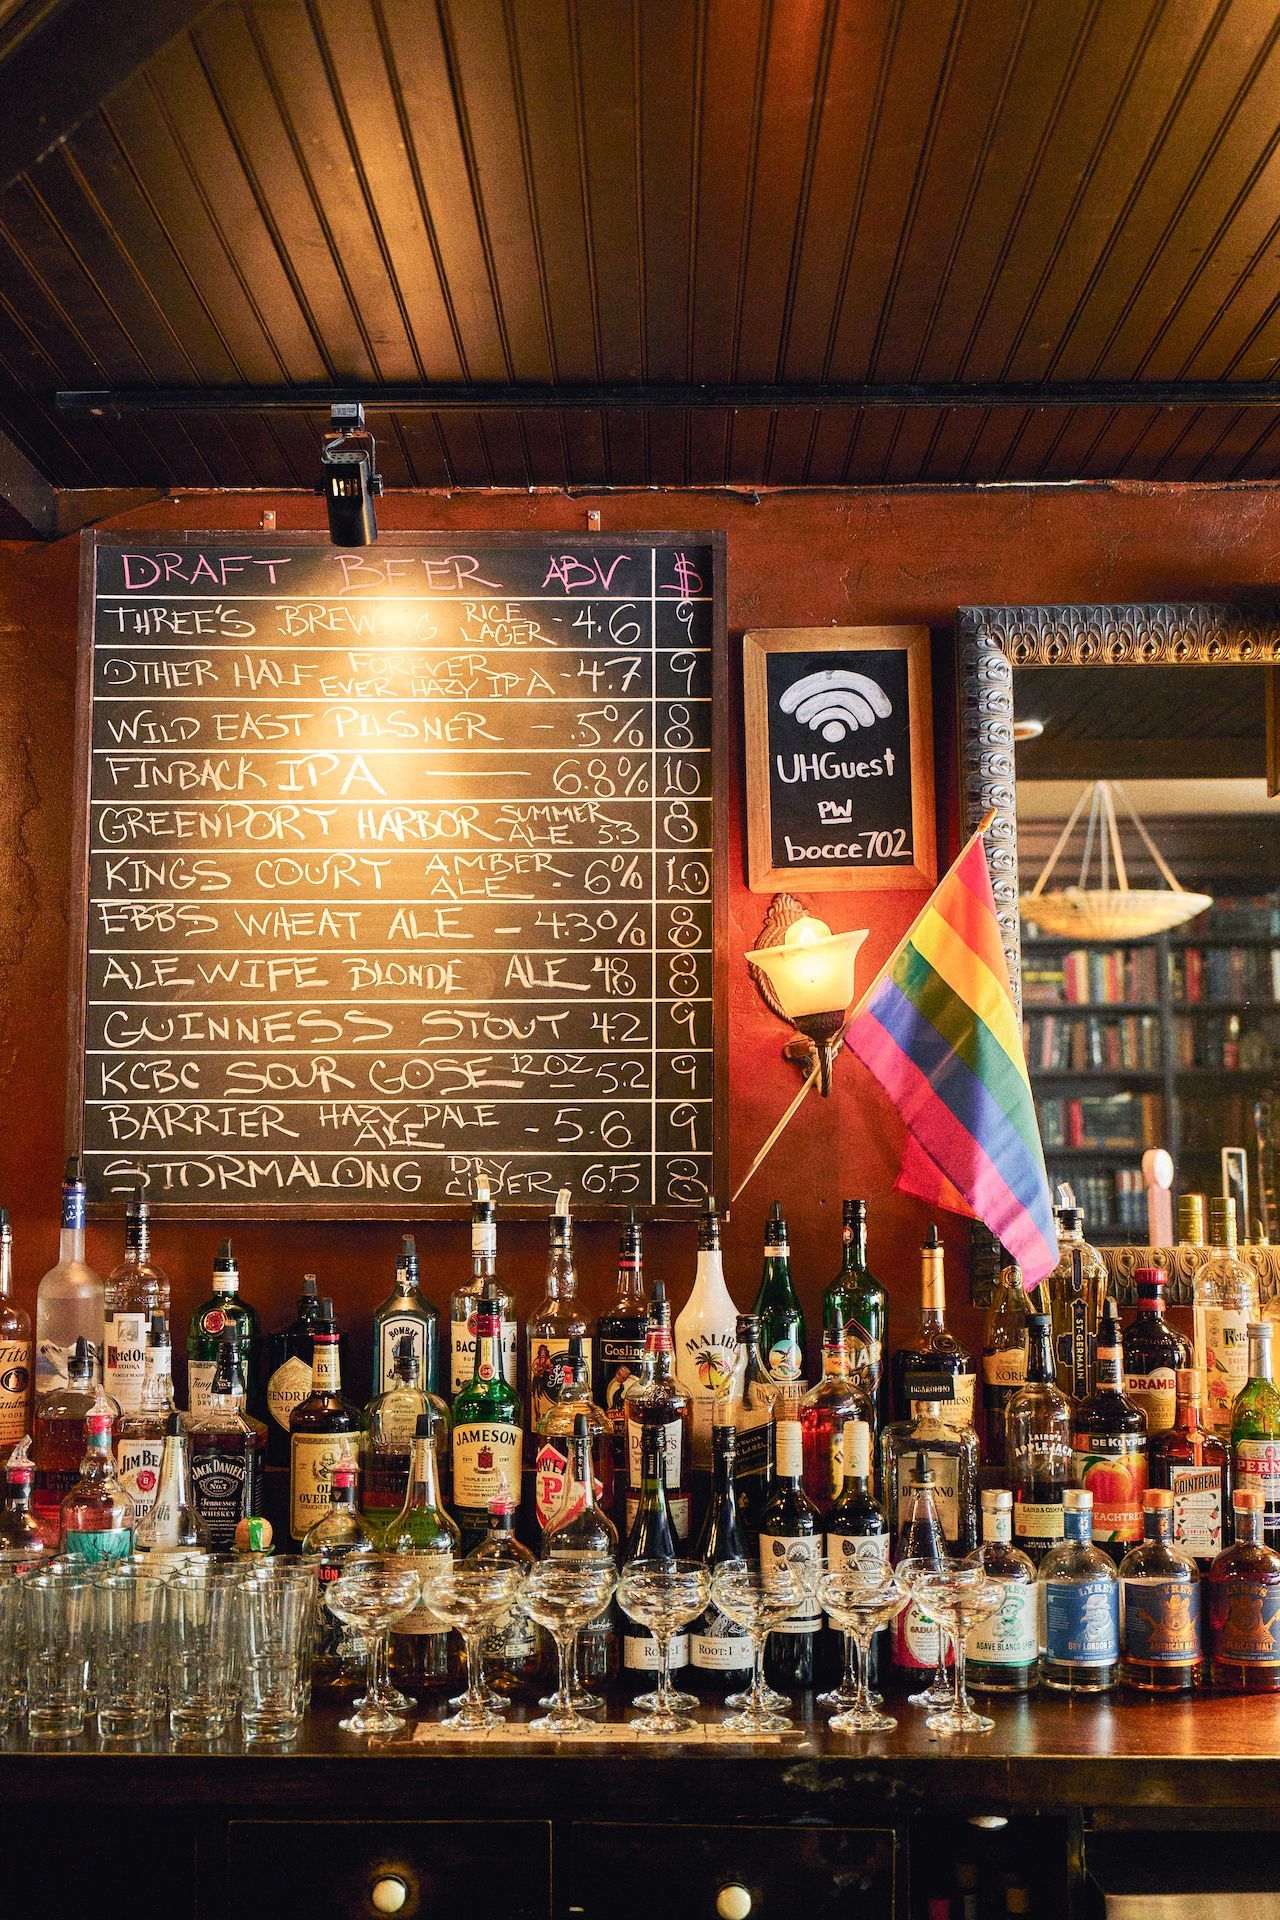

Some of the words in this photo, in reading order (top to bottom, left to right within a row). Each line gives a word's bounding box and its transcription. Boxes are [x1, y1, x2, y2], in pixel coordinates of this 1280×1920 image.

[121, 554, 291, 589] DRAFT
[333, 554, 503, 595] BEER
[541, 554, 631, 594] ABV
[660, 552, 703, 604] $
[103, 604, 256, 638] THREE'S
[275, 603, 437, 642] BREWG
[460, 620, 559, 646] LAGER
[676, 600, 694, 644] 9
[462, 602, 527, 624] RICE
[103, 658, 219, 690] OTHER
[234, 654, 319, 690] HALF
[319, 675, 399, 697] EVER
[412, 678, 479, 699] HAZY
[670, 651, 696, 696] 9
[348, 651, 498, 678] FOREVER
[108, 709, 201, 744] WILD
[211, 712, 315, 741] EAST
[323, 706, 504, 743] PILSNER
[664, 704, 694, 750] 8
[106, 754, 267, 792] FINBACK
[277, 753, 388, 797] IPA
[553, 756, 649, 797] 6.8%
[664, 756, 701, 795] 10
[777, 748, 895, 783] UHGuest
[99, 803, 338, 844] GREENPORT
[357, 805, 505, 842] HARBOR
[496, 801, 626, 825] SUMMER
[509, 823, 574, 848] ALE
[664, 800, 698, 843] 8
[817, 799, 852, 818] PW
[784, 828, 912, 861] bocce702
[105, 855, 232, 892] KINGS
[255, 852, 392, 890] COURT
[425, 852, 574, 878] AMBER
[430, 875, 535, 900] ALE
[584, 854, 643, 895] 6%
[666, 856, 710, 896] 10
[97, 902, 218, 937] EBBS
[234, 907, 362, 941] WHEAT
[387, 907, 474, 940] ALE
[668, 906, 702, 948] 8
[102, 956, 195, 991] ALE
[197, 956, 329, 992] WIFE
[341, 957, 468, 994] BLONDE
[505, 953, 591, 992] ALE
[669, 952, 699, 997] 8
[103, 1009, 394, 1048] GUINNESS
[418, 1009, 570, 1047] STOUT
[670, 1000, 697, 1046] 9
[101, 1059, 200, 1096] KCBC
[369, 1055, 525, 1096] GOSE
[671, 1054, 697, 1090] 9
[101, 1103, 300, 1141] BARRIER
[319, 1103, 409, 1140] HAZY
[416, 1103, 501, 1130] PALE
[670, 1103, 699, 1151] 9
[354, 1121, 446, 1150] ALE
[103, 1154, 422, 1193] STORMALONG
[446, 1155, 512, 1183] DRY
[667, 1158, 708, 1202] 8
[388, 1326, 419, 1338] BOMBAY
[1076, 1318, 1085, 1380] ST-GERMAIN
[1129, 1379, 1175, 1390] DRAMB
[456, 1429, 517, 1446] JAMESON
[1014, 1442, 1073, 1458] APPLEJACK
[120, 1455, 141, 1475] JIM
[192, 1465, 213, 1480] JACK
[213, 1460, 247, 1480] DANIEL'S
[1238, 1459, 1280, 1473] PERN
[317, 1485, 331, 1493] OL
[542, 1477, 562, 1504] P
[1175, 1473, 1220, 1494] COINTREAU
[201, 1498, 236, 1507] Tennessee
[1163, 1583, 1194, 1596] YRE'S
[699, 1643, 733, 1655] ROOT:1
[976, 1640, 995, 1651] AGAVE
